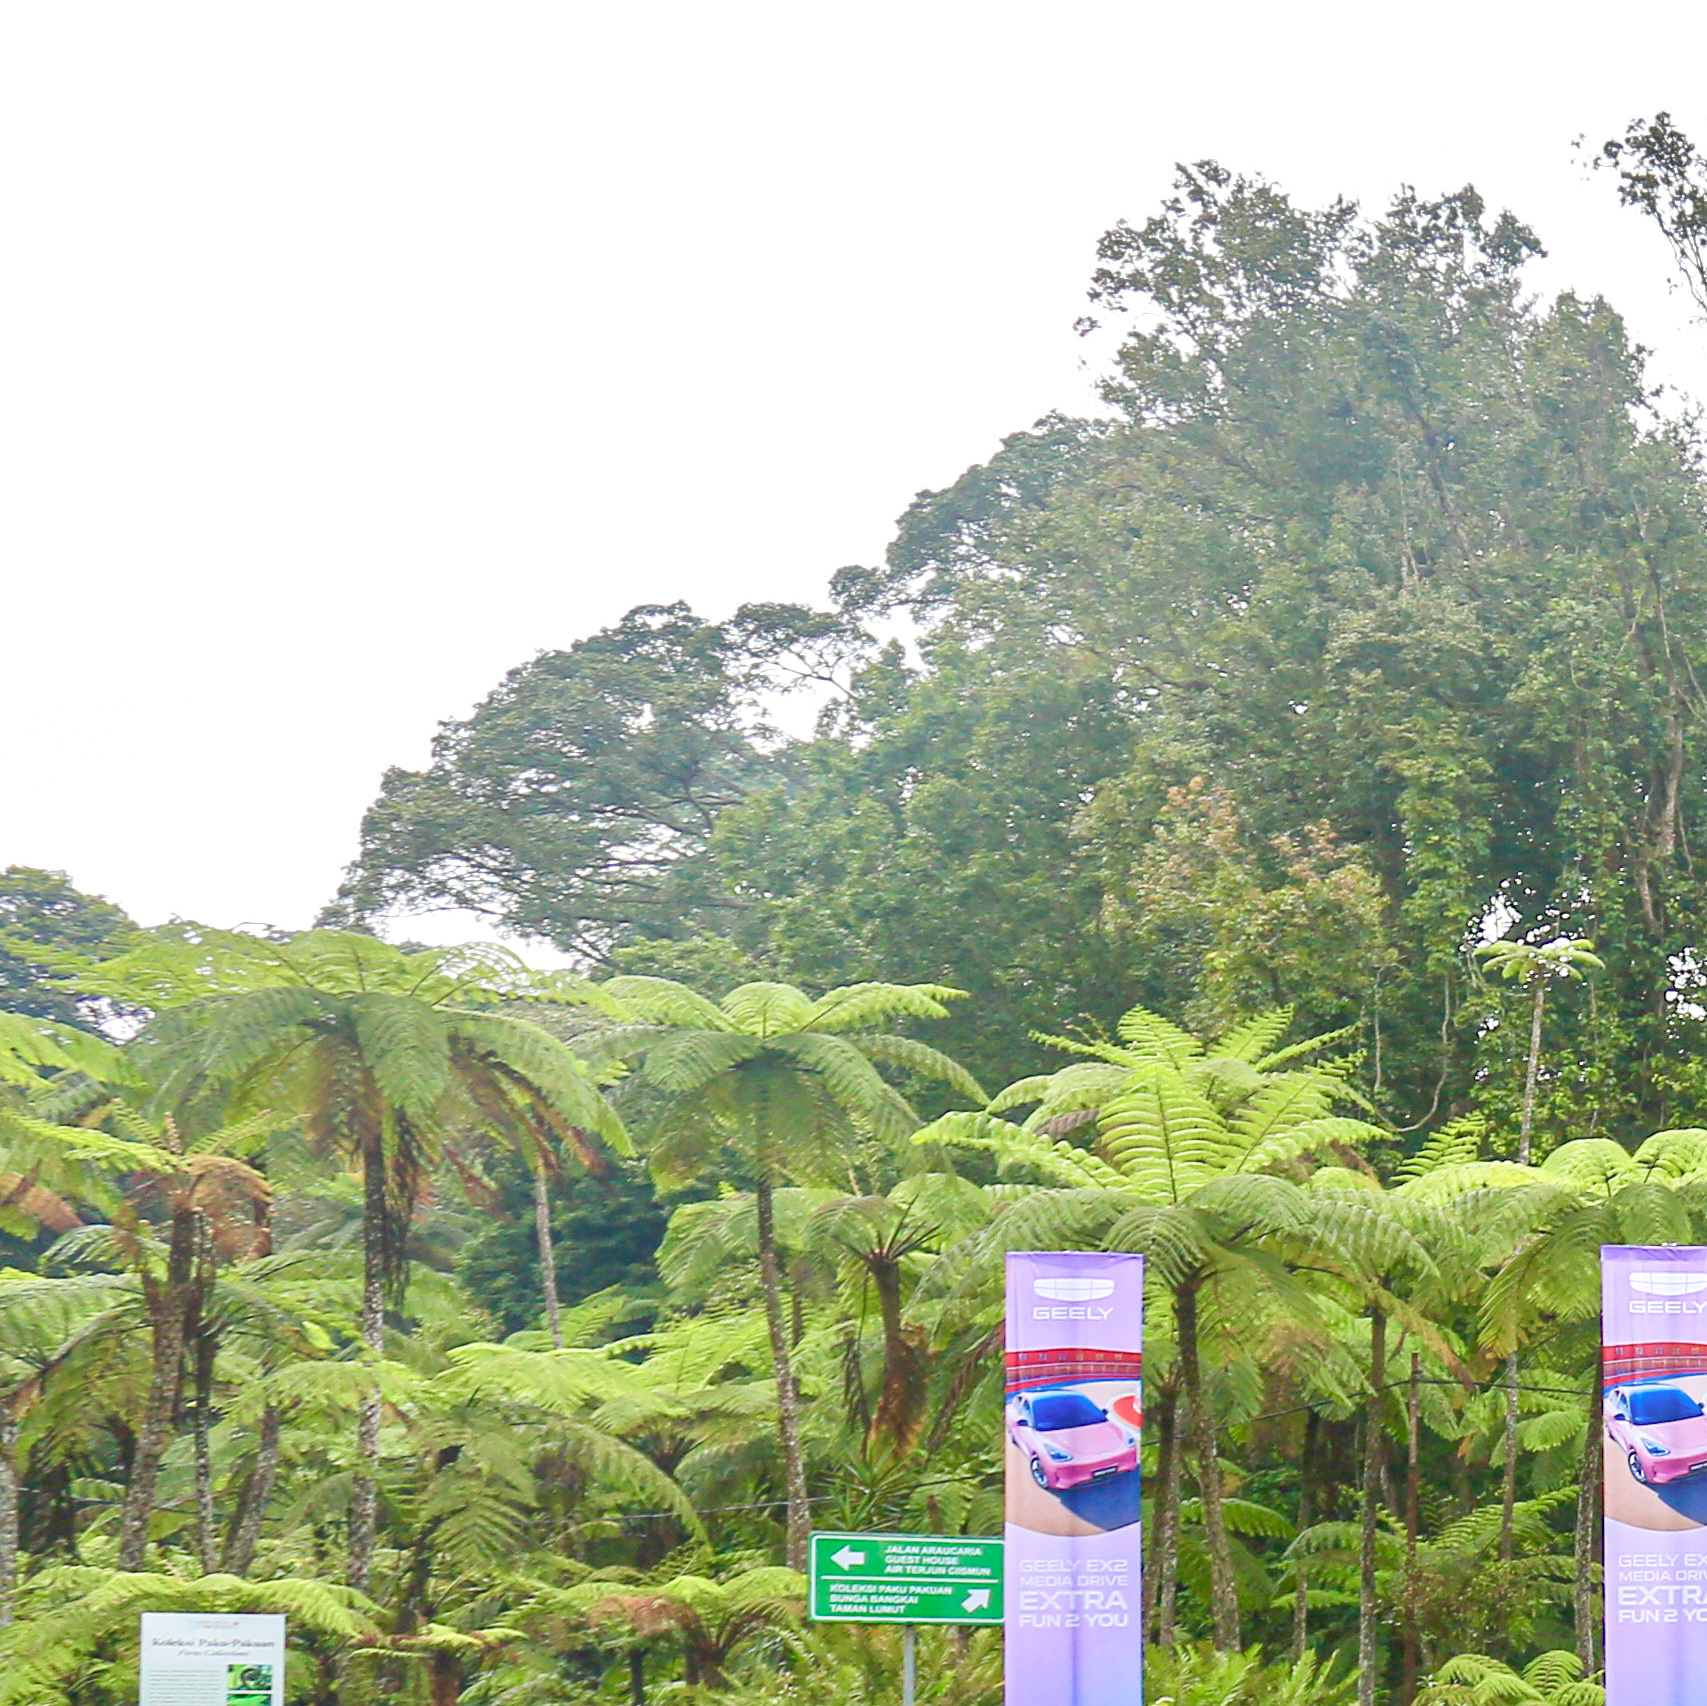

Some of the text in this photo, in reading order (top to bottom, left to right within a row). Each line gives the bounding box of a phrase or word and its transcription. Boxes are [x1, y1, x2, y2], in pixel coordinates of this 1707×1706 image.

[1033, 1307, 1115, 1320] GEELY
[885, 1545, 982, 1556] JALAN ARAUCARIA
[884, 1555, 960, 1565] GUEST HOUSE
[1020, 1559, 1128, 1572] GEELY EX2
[1618, 1554, 1680, 1567] GEELY
[884, 1565, 904, 1574] AIR
[906, 1566, 947, 1575] TERJUN
[1619, 1570, 1672, 1582] MEDIA
[1020, 1575, 1128, 1587] MEDIA DRIVE
[830, 1584, 953, 1595] KOLEKSI PAKU PAKUAN
[830, 1594, 919, 1604] BUNGA BANGKAI
[1019, 1590, 1127, 1611] EXTRA
[830, 1604, 906, 1614] TAMAN LUMUT
[1019, 1614, 1129, 1628] FUN 2 YOU
[1618, 1609, 1659, 1623] FUN
[1663, 1609, 1678, 1622] 2
